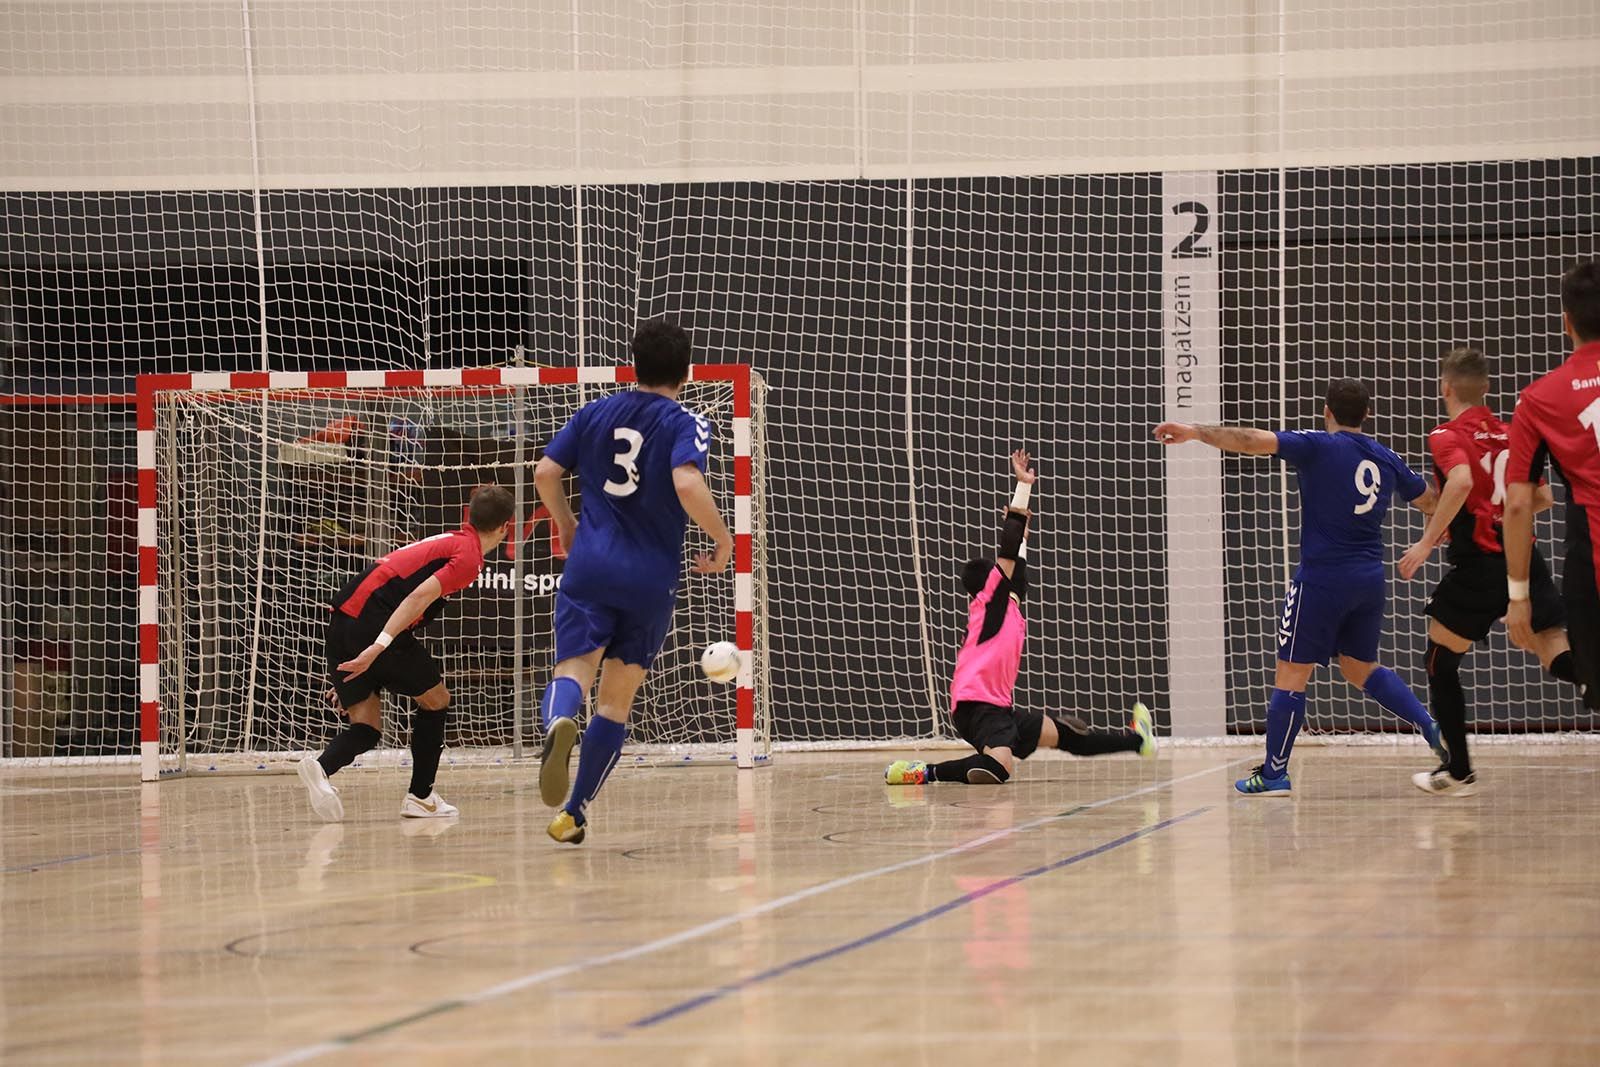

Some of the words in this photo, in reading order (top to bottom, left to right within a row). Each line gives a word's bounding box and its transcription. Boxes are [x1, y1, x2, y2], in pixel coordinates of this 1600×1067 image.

[1171, 201, 1212, 260] 2
[1172, 275, 1198, 409] magatzem
[603, 427, 644, 497] 3
[1354, 459, 1381, 515] 9
